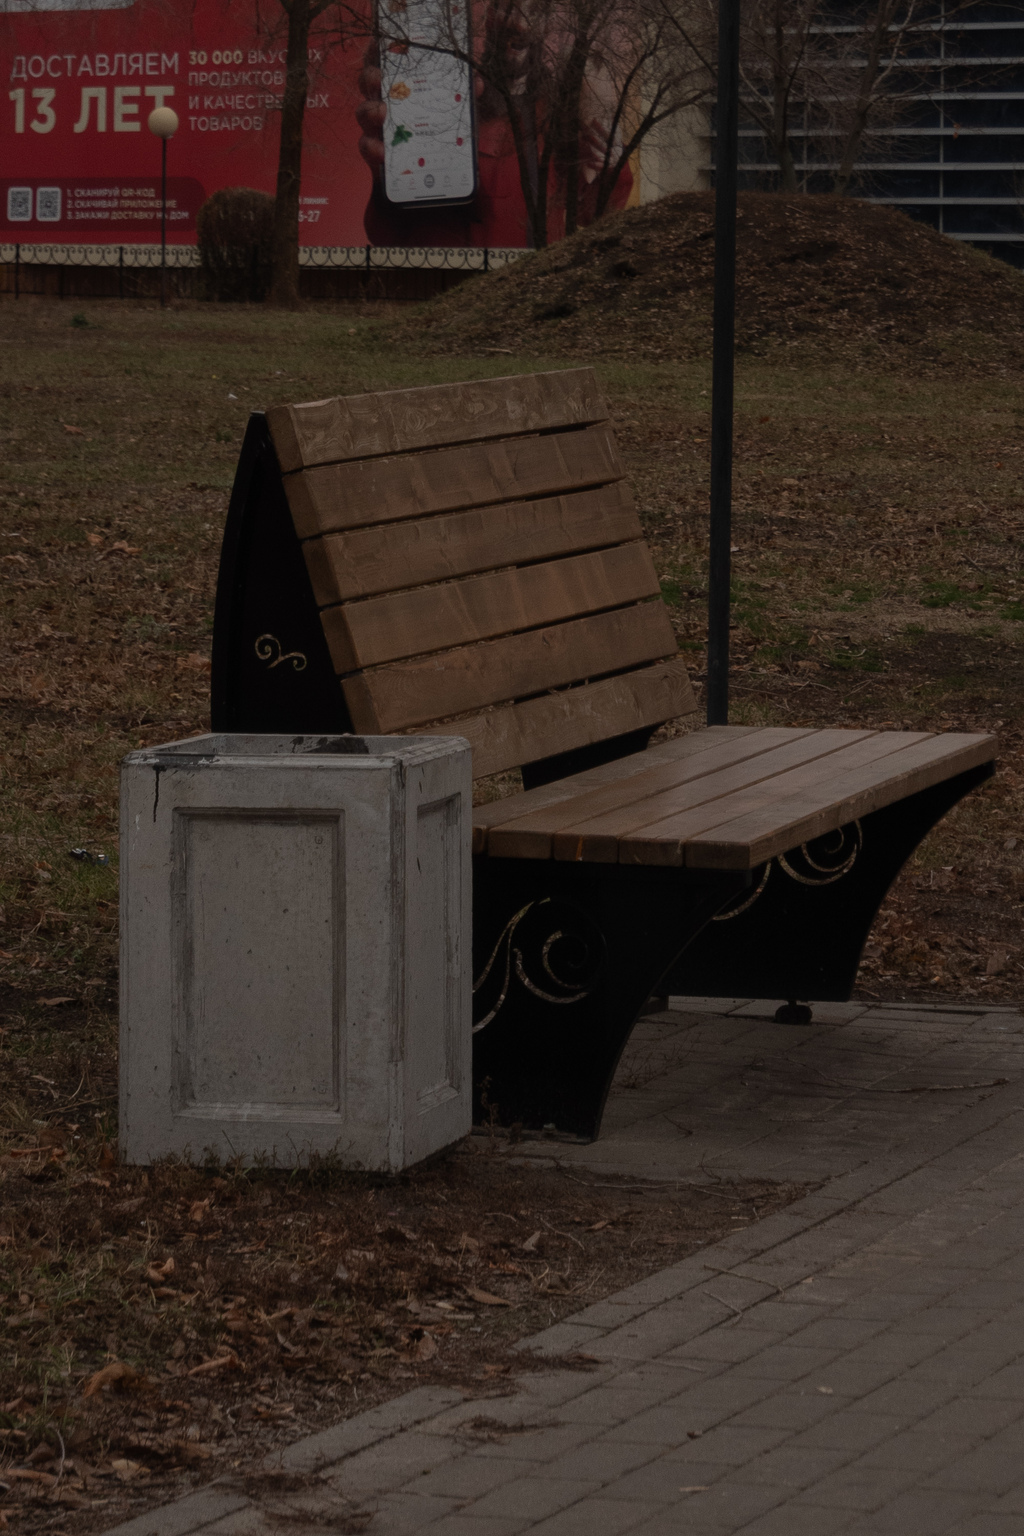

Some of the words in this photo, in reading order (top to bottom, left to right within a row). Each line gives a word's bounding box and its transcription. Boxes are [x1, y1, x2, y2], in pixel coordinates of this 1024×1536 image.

[188, 50, 208, 65] 30
[211, 50, 243, 65] 000
[10, 52, 179, 82] ДОСТАВЛЯЕМ
[188, 71, 284, 88] ПРОДУКТОВ
[8, 87, 56, 134] 13
[73, 85, 175, 134] ЛЕТ
[188, 95, 200, 110] И
[203, 93, 330, 110] КАЧЕСТВЕЫХ
[188, 116, 264, 132] ТОВАРОВ
[73, 186, 120, 197] СКАНИРУЙ
[110, 210, 155, 220] ДОСТАВКУ
[169, 210, 189, 220] ДОМ
